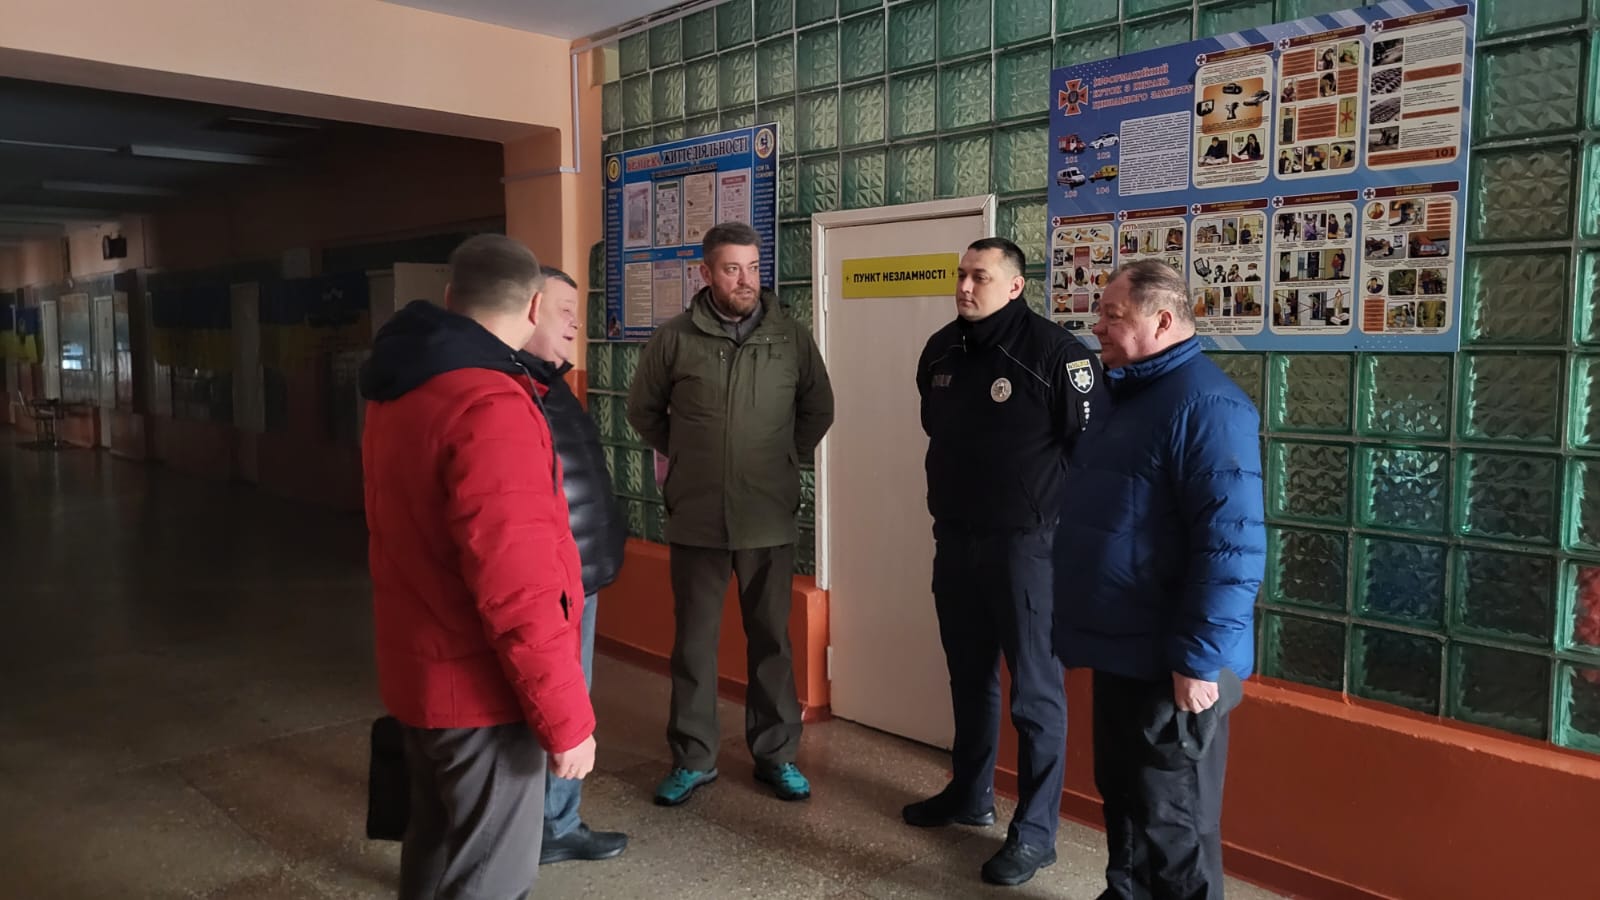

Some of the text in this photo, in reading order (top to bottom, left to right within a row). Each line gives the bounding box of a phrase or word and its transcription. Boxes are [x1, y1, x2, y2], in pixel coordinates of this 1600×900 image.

[663, 136, 748, 165] ЖИТТЄДІЯЛЬНОСТІ
[1435, 148, 1455, 158] 101
[1065, 156, 1078, 165] 101
[854, 269, 946, 283] ПУНКТ НЕЗЛАМНОСТІ
